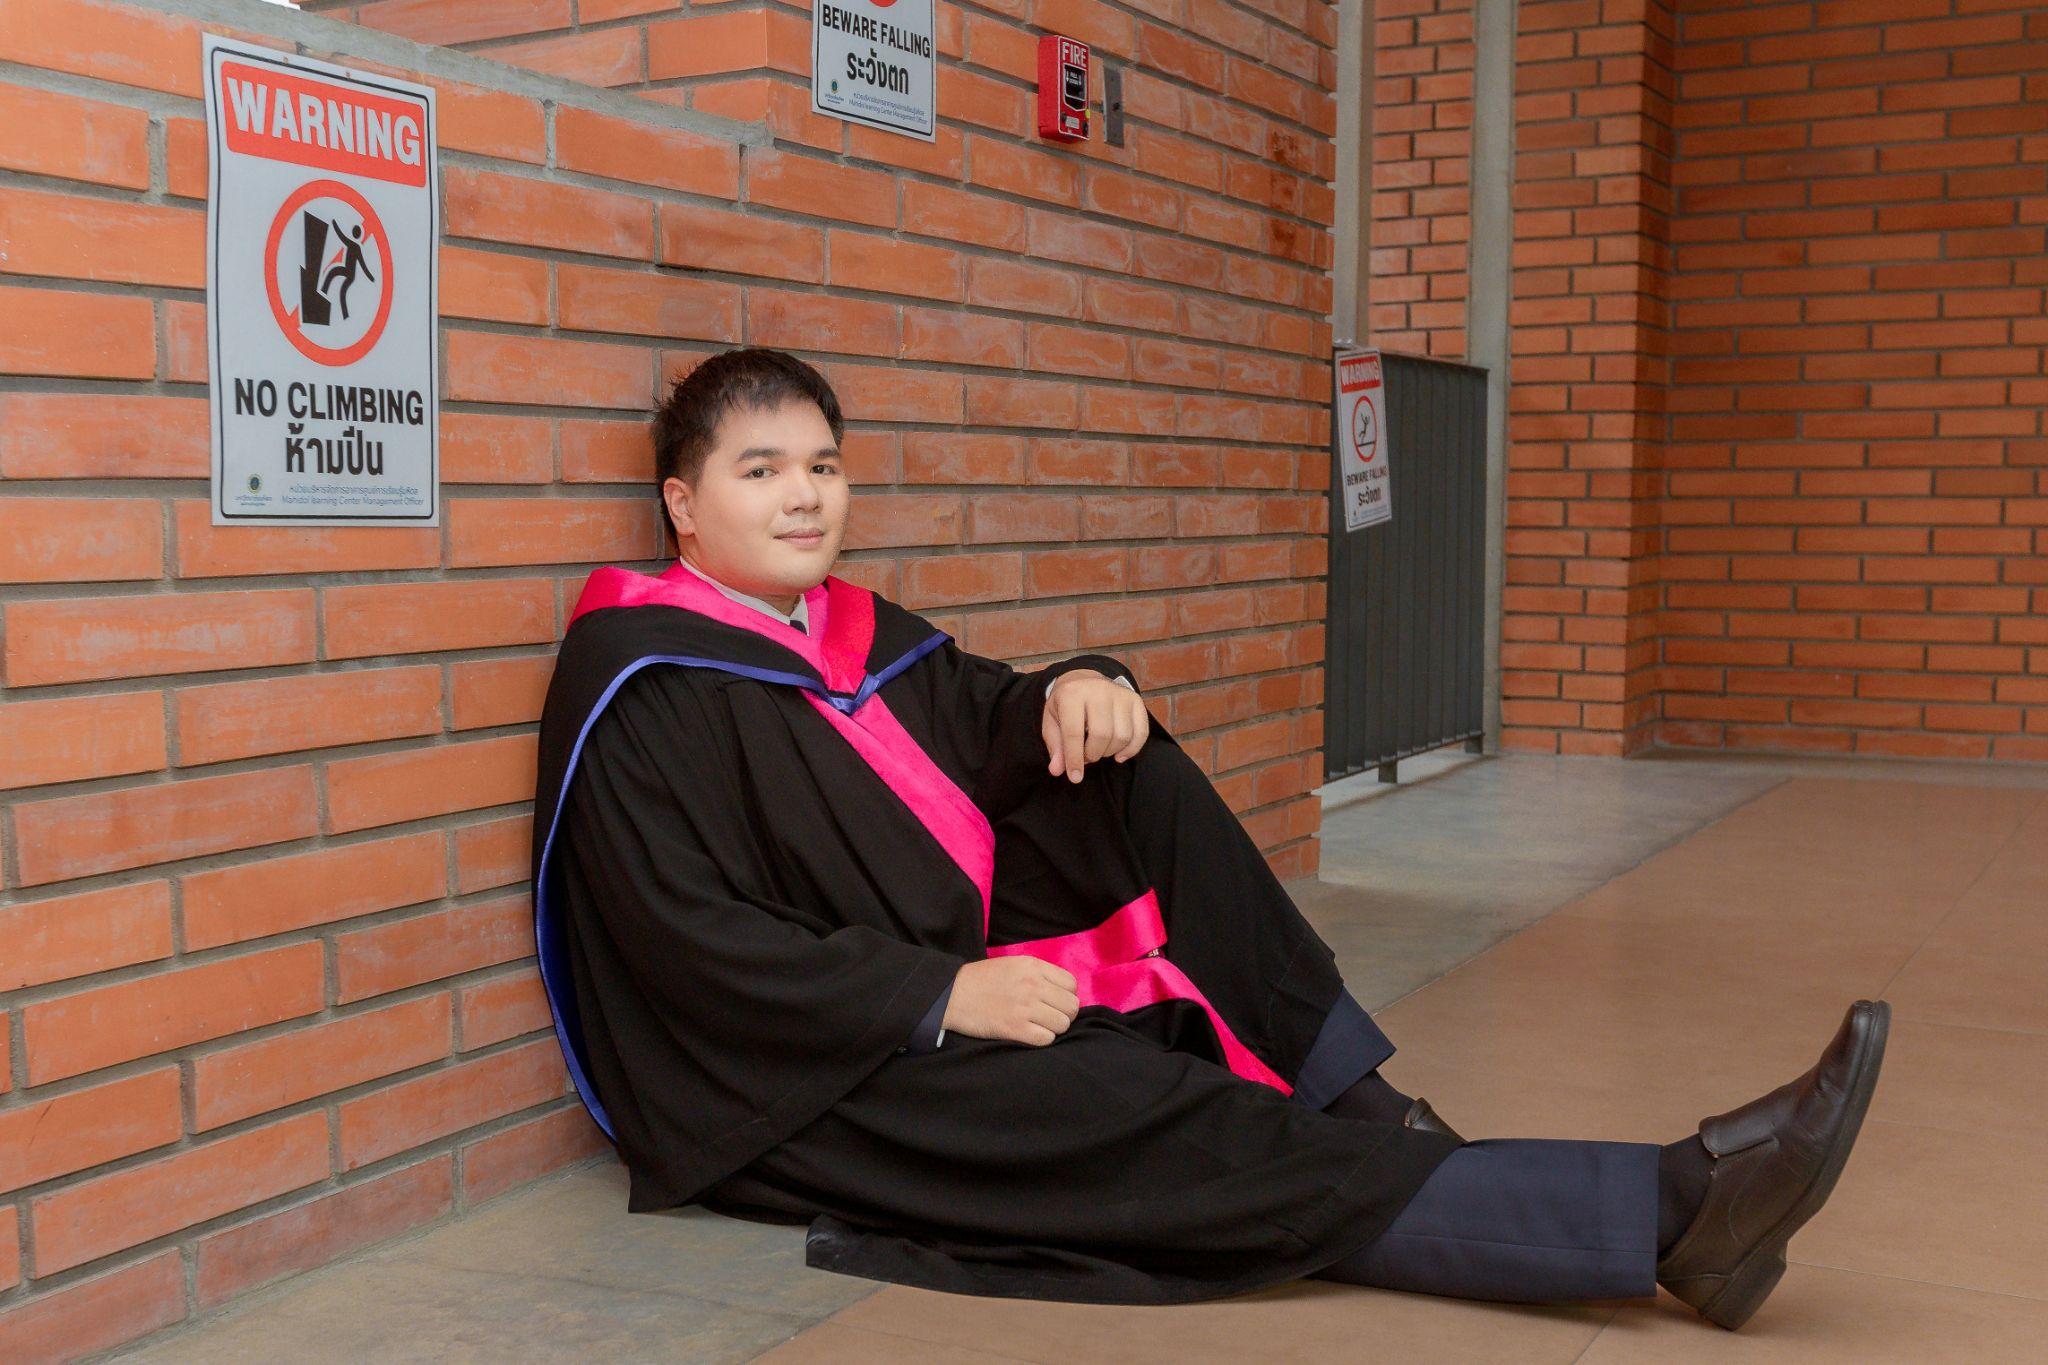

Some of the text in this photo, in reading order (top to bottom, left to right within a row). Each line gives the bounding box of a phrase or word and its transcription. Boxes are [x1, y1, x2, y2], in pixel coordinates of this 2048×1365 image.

[822, 4, 931, 59] BEWARE FALLING
[1062, 41, 1087, 68] FIRE
[846, 48, 909, 95] ระวังตก
[227, 77, 421, 167] WARNING
[1341, 360, 1379, 386] WARNING
[234, 378, 424, 426] NO CLIMBING
[285, 422, 384, 476] ห้ามปีน
